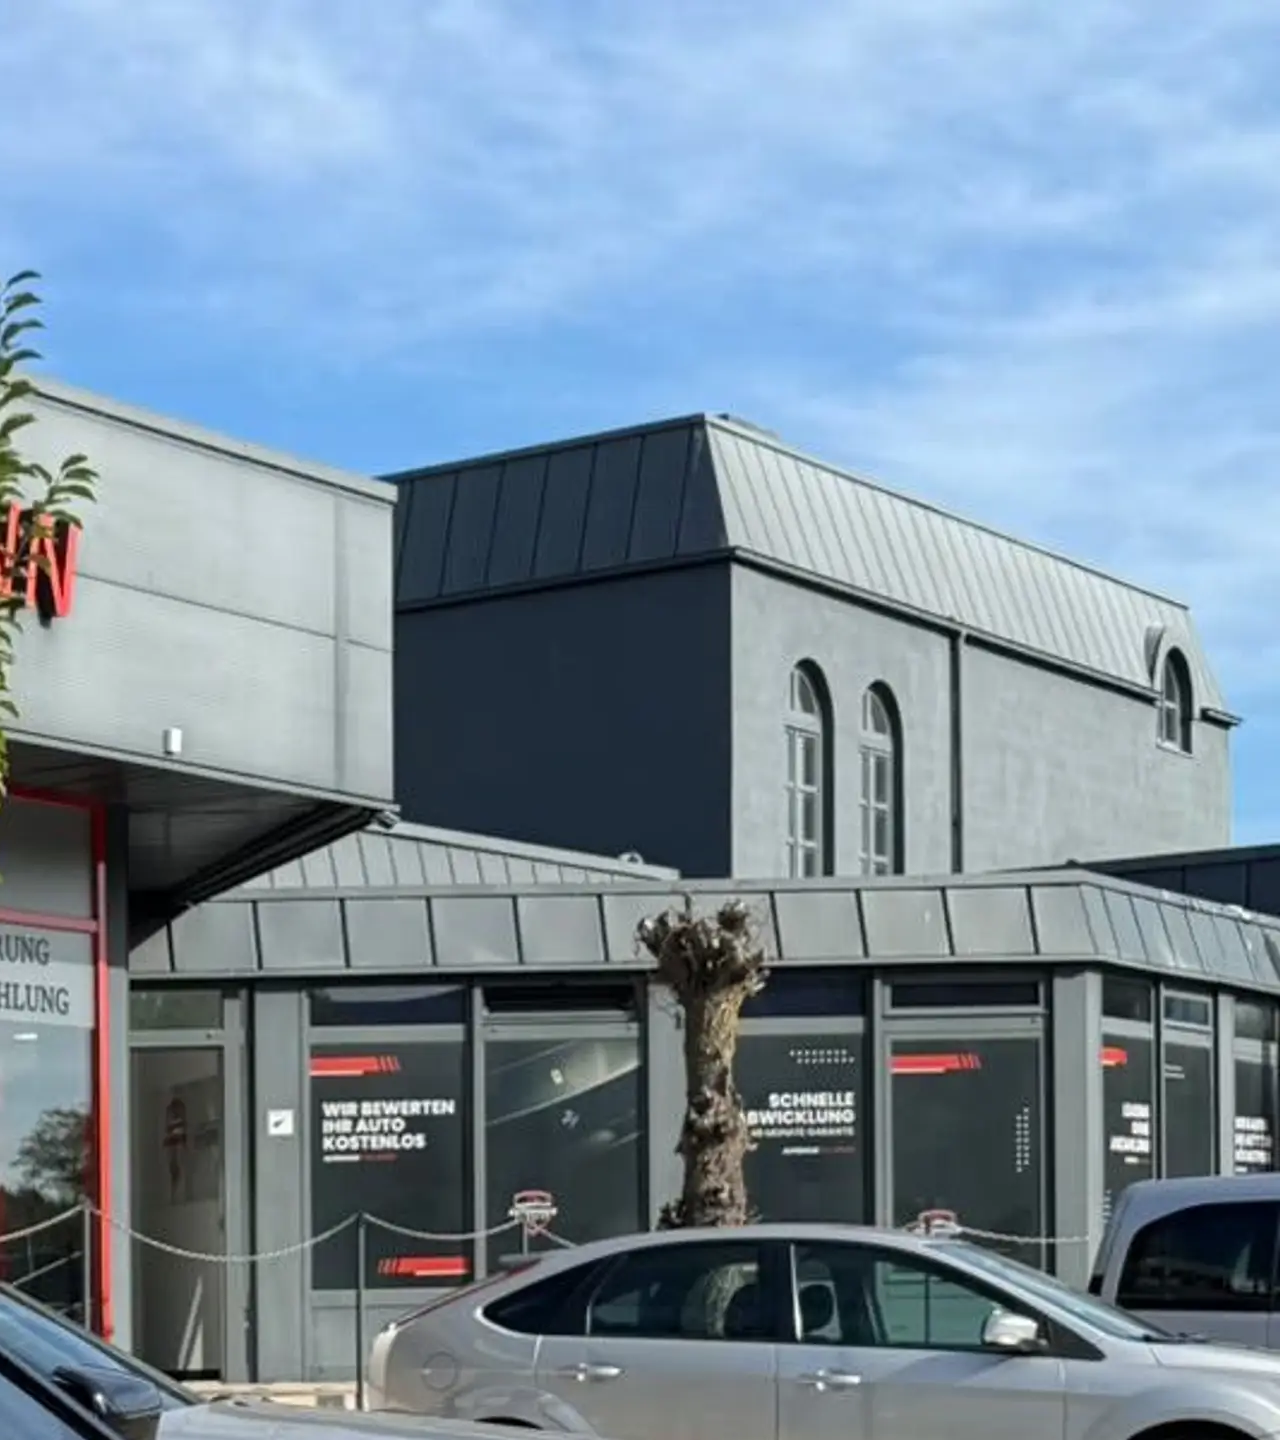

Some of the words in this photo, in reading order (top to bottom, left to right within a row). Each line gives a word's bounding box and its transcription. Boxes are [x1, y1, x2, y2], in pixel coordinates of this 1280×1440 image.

[360, 1098, 456, 1116] BEWERTEN
[768, 1091, 855, 1108] SCHNELLE
[355, 1117, 407, 1132] AUTO
[321, 1132, 427, 1151] KOSTENLOS
